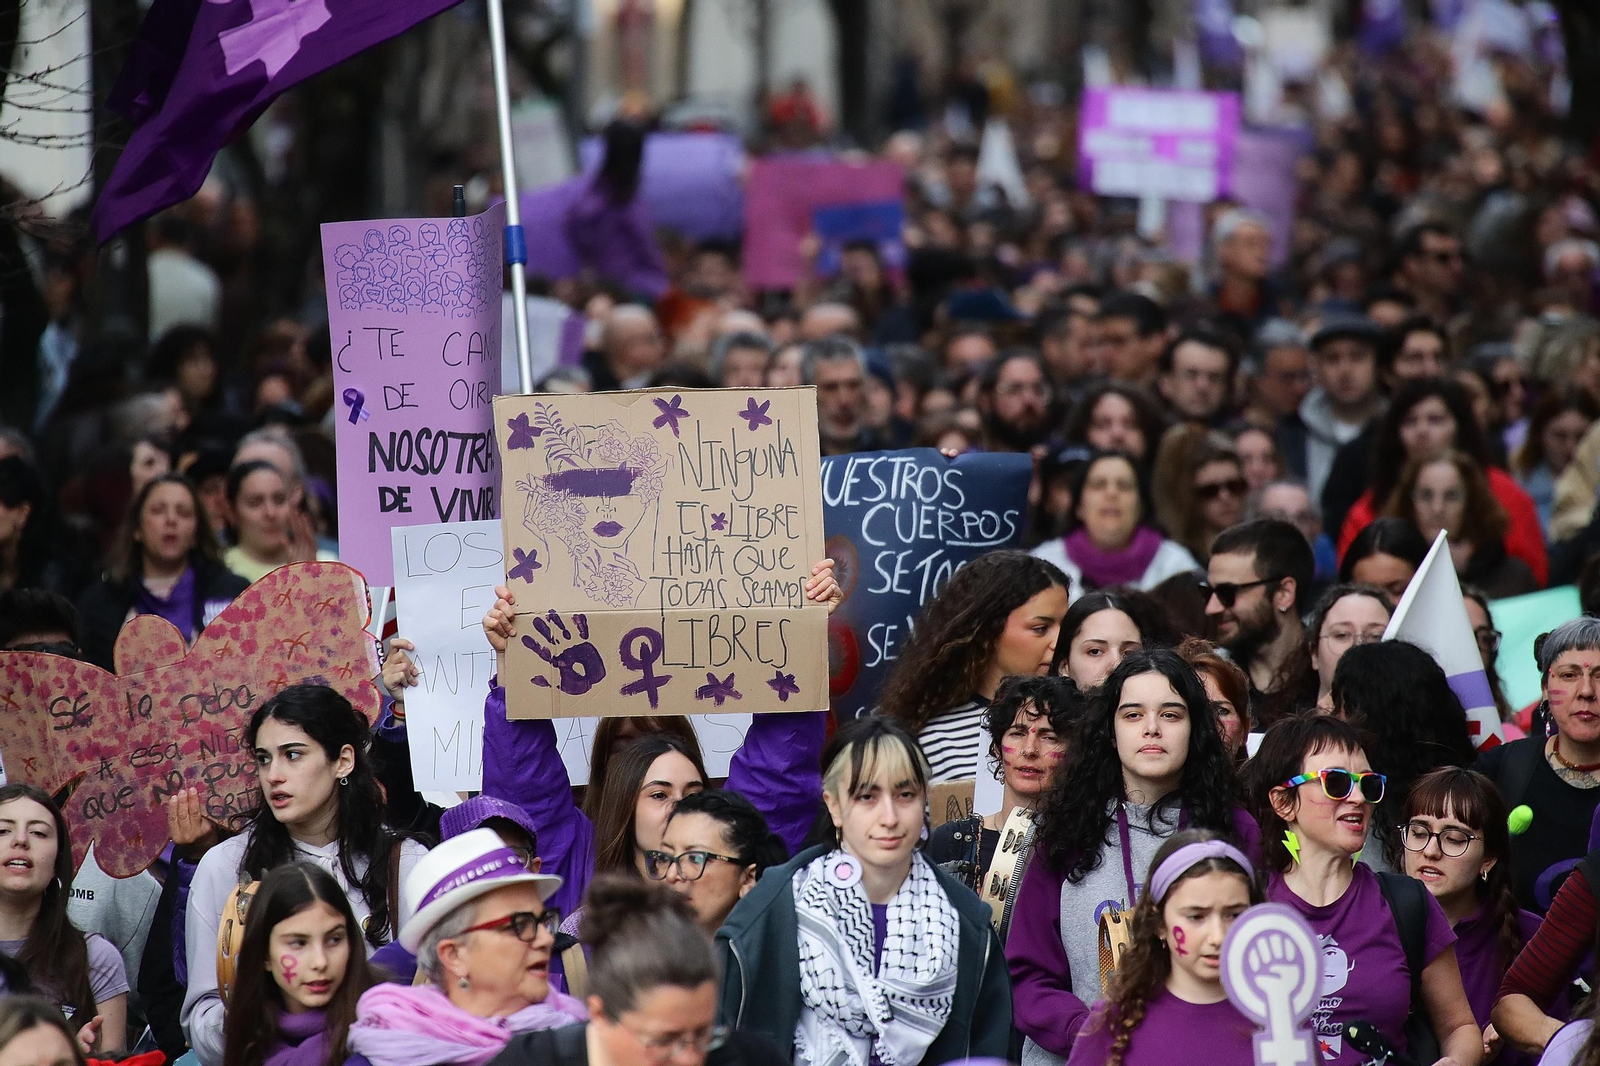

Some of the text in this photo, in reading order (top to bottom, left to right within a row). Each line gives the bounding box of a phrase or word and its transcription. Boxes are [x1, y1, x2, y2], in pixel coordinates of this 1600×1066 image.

[383, 383, 419, 411] DE
[368, 427, 495, 475] NOSOTRA
[820, 456, 966, 510] UESTROS
[378, 486, 496, 524] DE VIVIR
[675, 501, 800, 543] ES LIBRE
[861, 502, 1019, 546] CUERPOS
[403, 532, 504, 577] LOS
[661, 536, 725, 576] HASTA
[649, 576, 728, 617] TODAS
[661, 614, 791, 669] LIBRES
[865, 623, 898, 668] SE
[130, 741, 183, 769] esa
[152, 770, 184, 804] NO
[1316, 1020, 1343, 1037] lase
